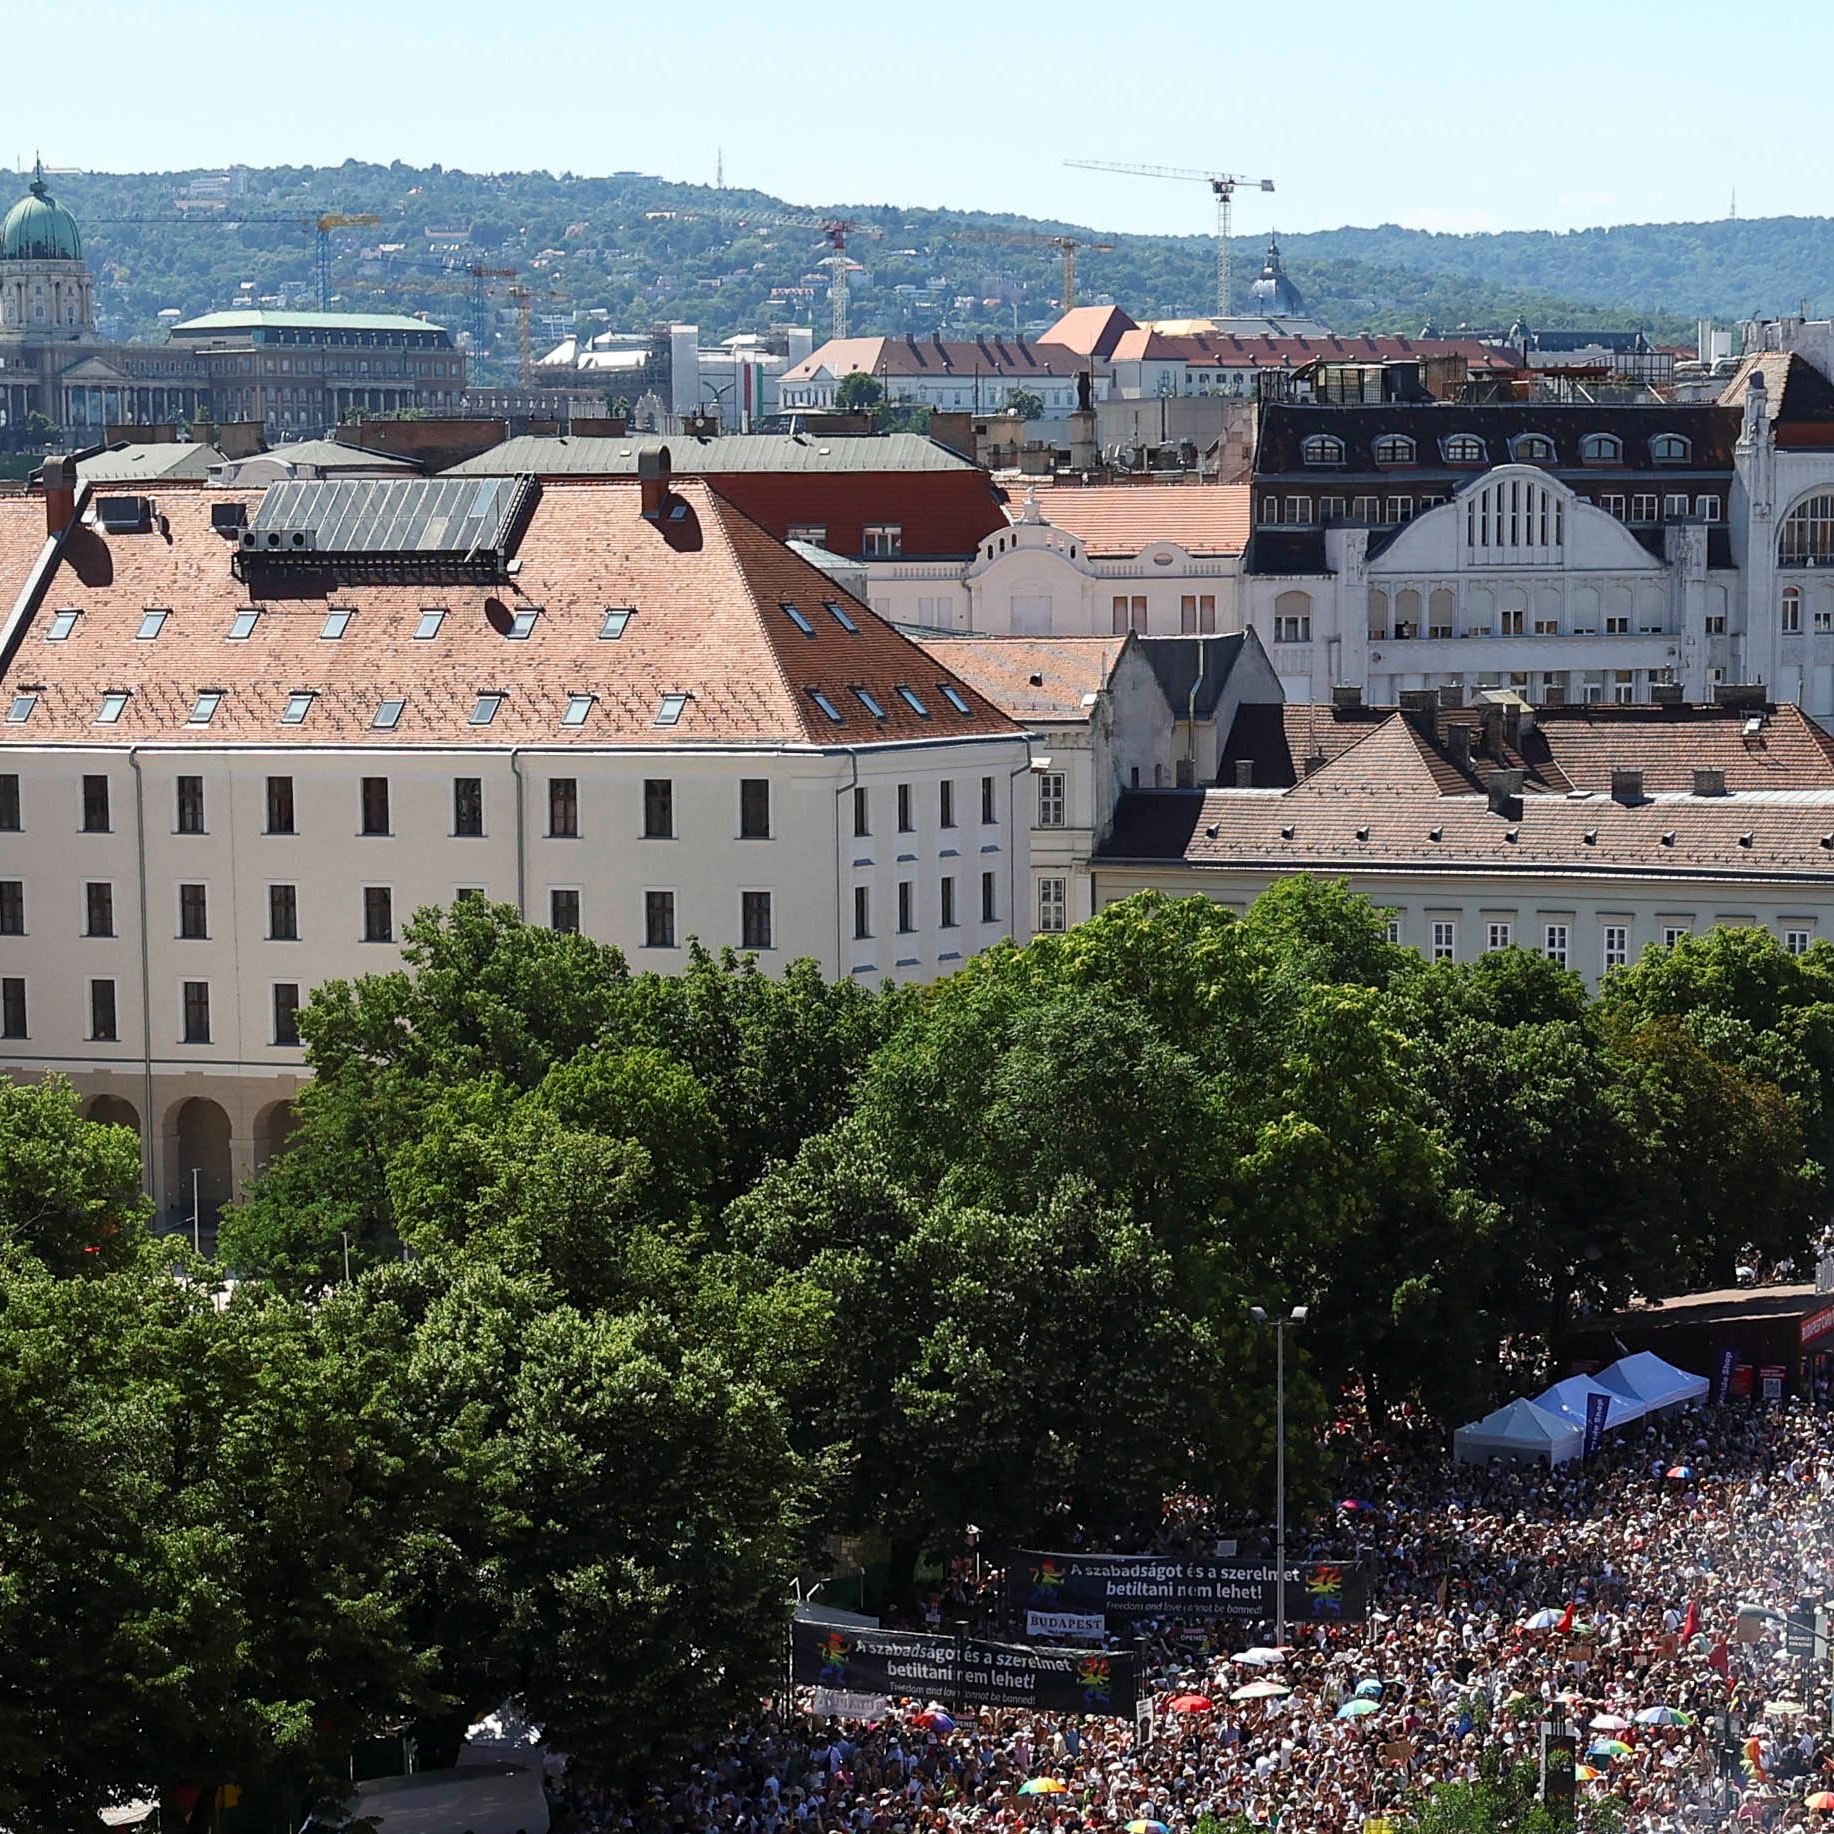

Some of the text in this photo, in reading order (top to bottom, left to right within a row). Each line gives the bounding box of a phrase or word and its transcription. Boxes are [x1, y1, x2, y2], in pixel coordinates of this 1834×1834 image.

[1071, 1565, 1082, 1576] A
[1086, 1562, 1182, 1582] szabadságot
[1106, 1582, 1173, 1598] betiltani
[1217, 1583, 1262, 1600] lehet!
[1030, 1616, 1102, 1630] BUDAPEST
[855, 1639, 867, 1652] A
[983, 1654, 992, 1664] a
[996, 1652, 1072, 1672] szerelmet
[887, 1659, 953, 1680] betiltani
[991, 1669, 1035, 1689] lehet!
